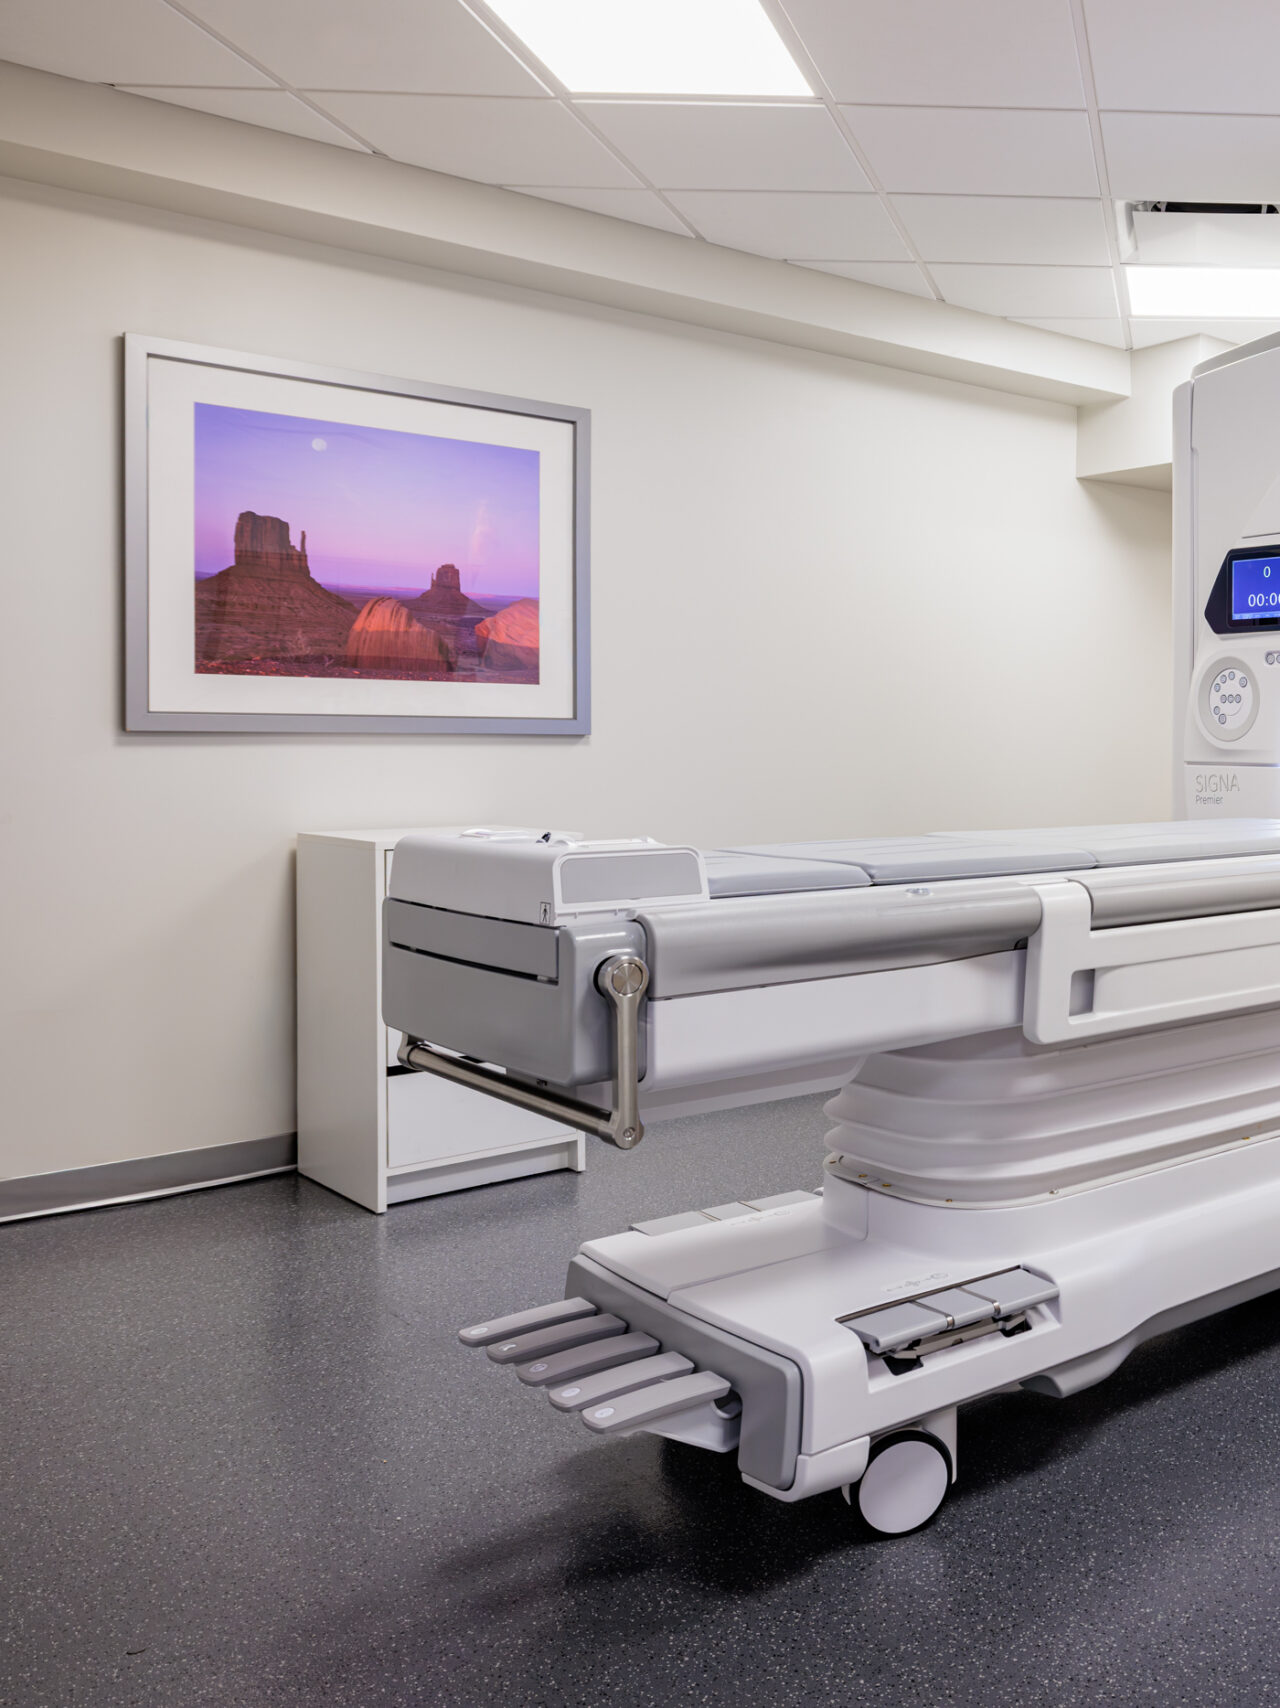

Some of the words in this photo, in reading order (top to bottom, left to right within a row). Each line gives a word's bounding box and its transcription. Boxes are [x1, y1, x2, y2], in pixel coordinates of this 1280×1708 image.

[1263, 565, 1271, 578] 0
[1195, 773, 1240, 793] SIGNA
[1195, 794, 1224, 805] Premier
